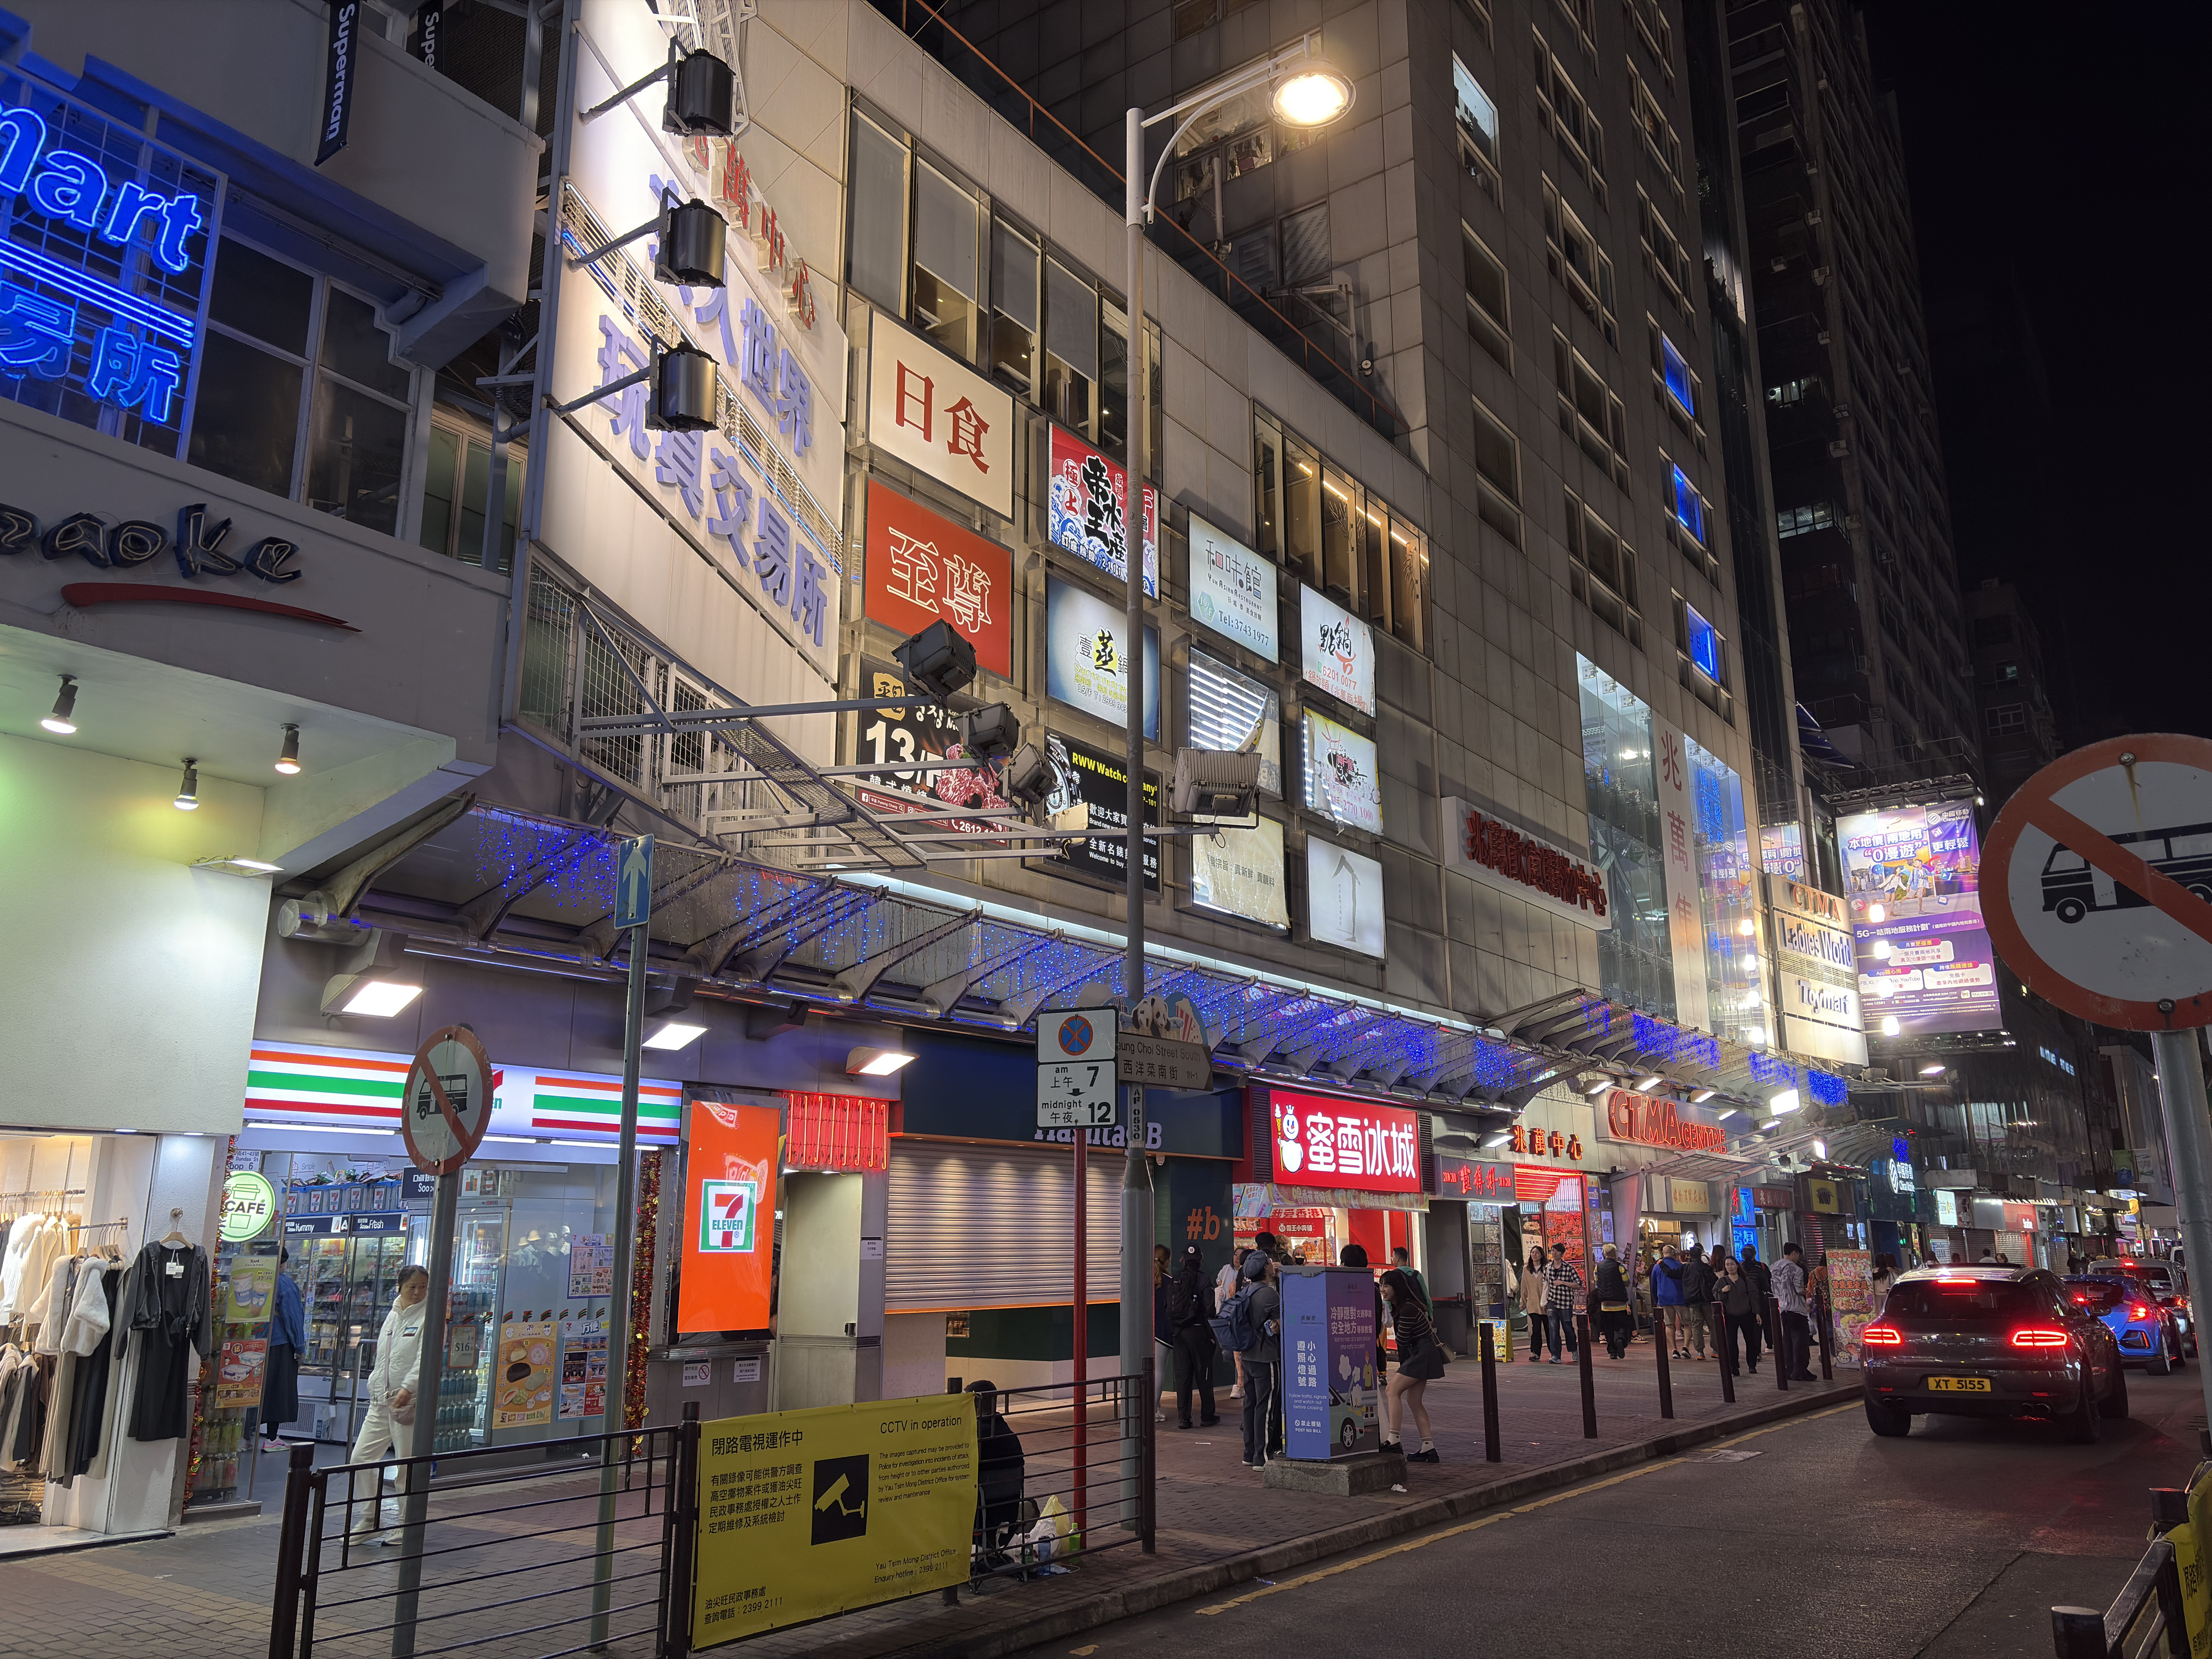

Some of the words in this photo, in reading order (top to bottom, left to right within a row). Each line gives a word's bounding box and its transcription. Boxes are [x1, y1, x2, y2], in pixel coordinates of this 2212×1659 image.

[327, 3, 355, 141] Superman
[895, 359, 990, 474] 日食
[886, 526, 993, 633] 至尊
[1253, 628, 1269, 645] 1977
[1323, 666, 1338, 682] 6201
[1341, 675, 1357, 691] 0077
[1078, 685, 1092, 696] 15/F
[1102, 695, 1116, 707] 2989
[1072, 752, 1095, 771] RWW
[1097, 761, 1121, 782] Watch
[1343, 800, 1357, 815] 2770
[1360, 807, 1373, 822] 1000
[1942, 809, 1969, 817] 中國移動
[1089, 818, 1100, 828] Brand
[1849, 835, 1884, 849] 本地價
[1932, 837, 1969, 853] 更輕鬆
[1089, 852, 1108, 863] Welcome
[1792, 885, 1841, 922] CTMA
[1778, 917, 1820, 957] Ladies
[1819, 930, 1853, 967] World
[1137, 1042, 1154, 1054] Choi
[1156, 1045, 1178, 1058] Street
[1180, 1048, 1200, 1062] South
[1087, 1066, 1099, 1087] 7
[1123, 1060, 1177, 1081] 西洋菜南街
[1051, 1076, 1073, 1088] 上午
[1042, 1099, 1082, 1109] midnight
[1088, 1102, 1110, 1123] 12
[1050, 1112, 1073, 1124] 午夜
[1612, 1091, 1681, 1147] CTMA
[1682, 1121, 1727, 1154] CENTRE
[1307, 1112, 1416, 1178] 蜜雪冰城
[1514, 1125, 1583, 1160] 兆萬中心
[296, 1223, 315, 1233] Yummy
[369, 1219, 384, 1229] Fresh
[1187, 1206, 1220, 1240] #b
[1331, 1307, 1356, 1320] 冷靜應對
[1332, 1321, 1357, 1335] 安全地方
[1297, 1341, 1306, 1387] 遵照燈號
[1307, 1341, 1317, 1387] 小心過路
[1934, 1379, 1950, 1389] XT
[1957, 1380, 1985, 1390] 5155
[880, 1420, 907, 1434] CCTV
[911, 1420, 918, 1431] in
[921, 1416, 962, 1431] operation
[712, 1429, 803, 1457] 閉路電視運作中
[889, 1451, 905, 1459] images
[906, 1448, 926, 1457] captured
[945, 1443, 963, 1452] provided
[890, 1472, 905, 1480] height
[931, 1466, 946, 1474] parties
[947, 1463, 969, 1472] authorized
[899, 1458, 924, 1467] investigation
[934, 1454, 951, 1463] incidents
[711, 1463, 802, 1487] 有關錄像可能供警方調查
[905, 1480, 917, 1489] Mong
[710, 1478, 802, 1503] 高空擲物案件或獲油尖旺
[903, 1490, 931, 1499] maintenance
[709, 1493, 801, 1519] 民政事務處授權之人士作
[708, 1510, 785, 1535] 定期維修及系統檢討
[875, 1561, 886, 1570] Yau
[888, 1558, 901, 1568] Tsim
[903, 1555, 919, 1566] Mong
[920, 1551, 939, 1563] District
[940, 1548, 956, 1559] Office
[874, 1571, 894, 1584] Enquiry
[919, 1564, 933, 1574] 2399
[935, 1561, 948, 1571] 2111
[705, 1585, 766, 1610] 油尖旺民政事務處
[743, 1601, 762, 1615] 2399
[764, 1597, 782, 1609] 2111
